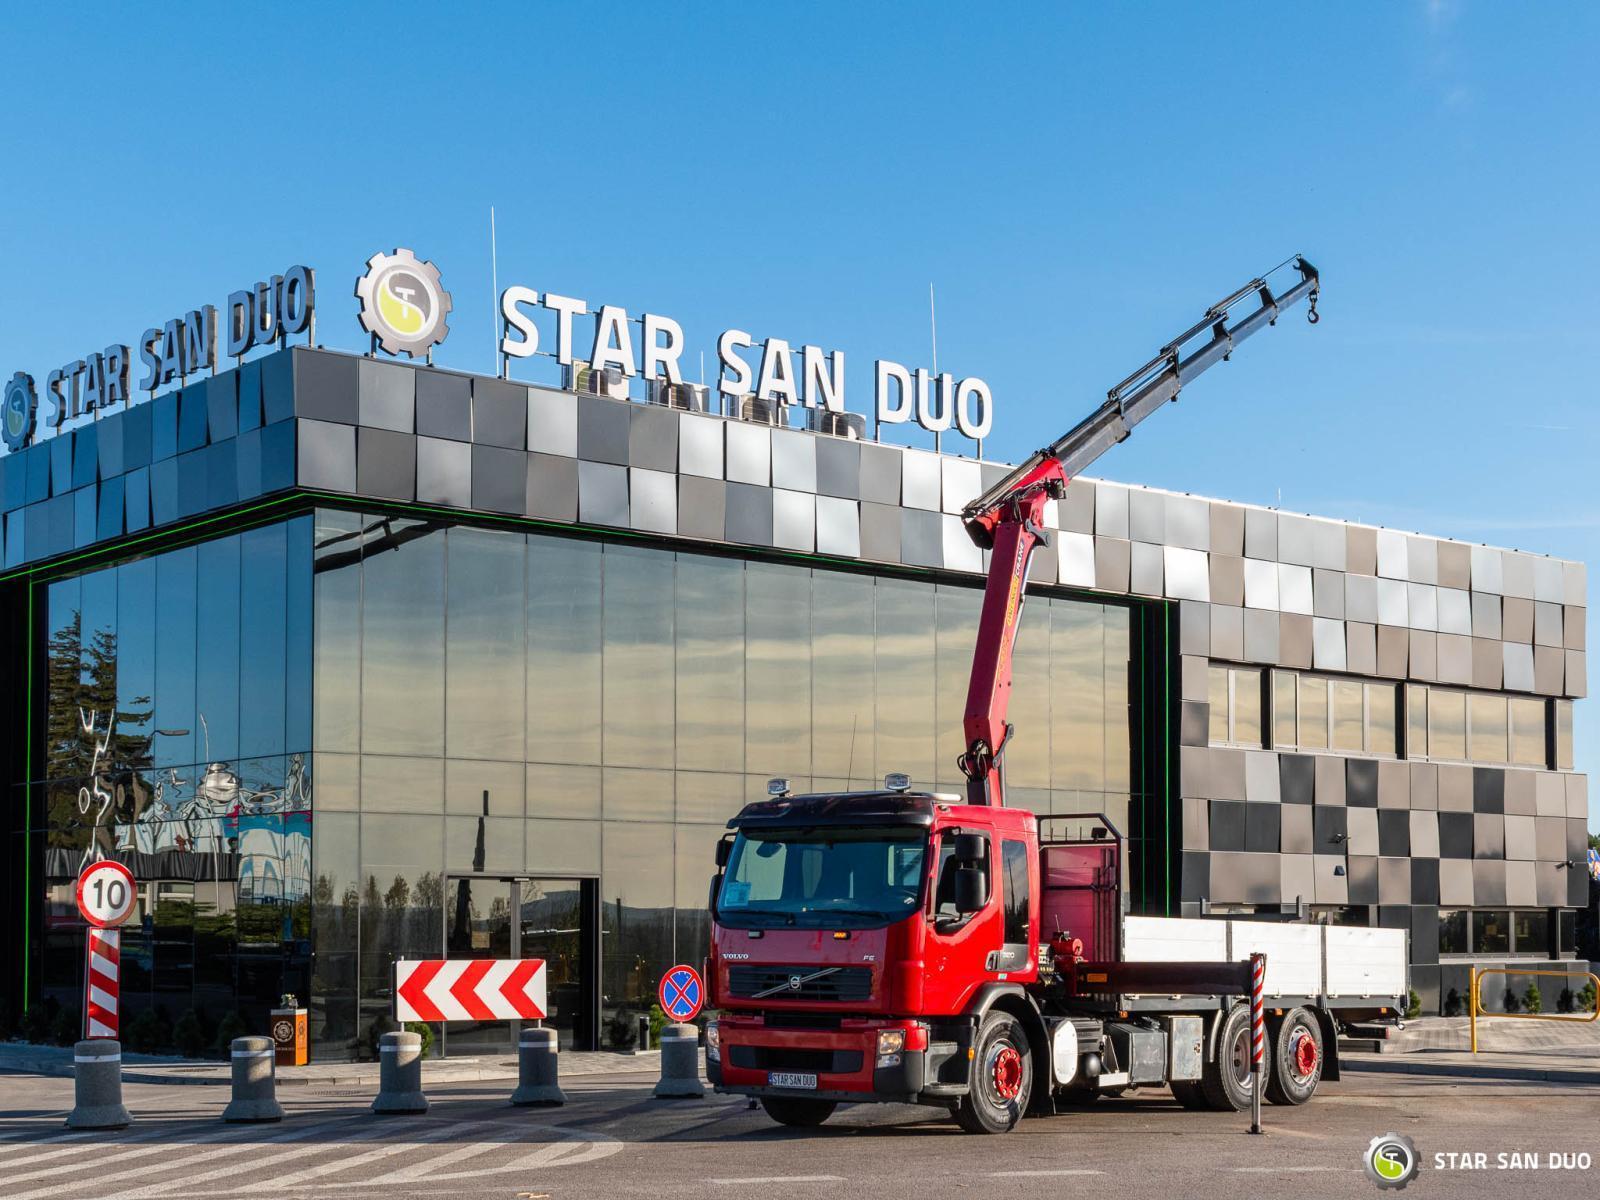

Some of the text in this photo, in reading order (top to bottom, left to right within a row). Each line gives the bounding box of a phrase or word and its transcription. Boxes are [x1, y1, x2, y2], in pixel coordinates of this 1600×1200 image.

[46, 264, 312, 428] STAR SAN DUO
[500, 285, 993, 440] STAR SAN DUO
[1014, 542, 1025, 577] CRANE
[93, 878, 126, 910] 10
[722, 952, 749, 960] VOLVO
